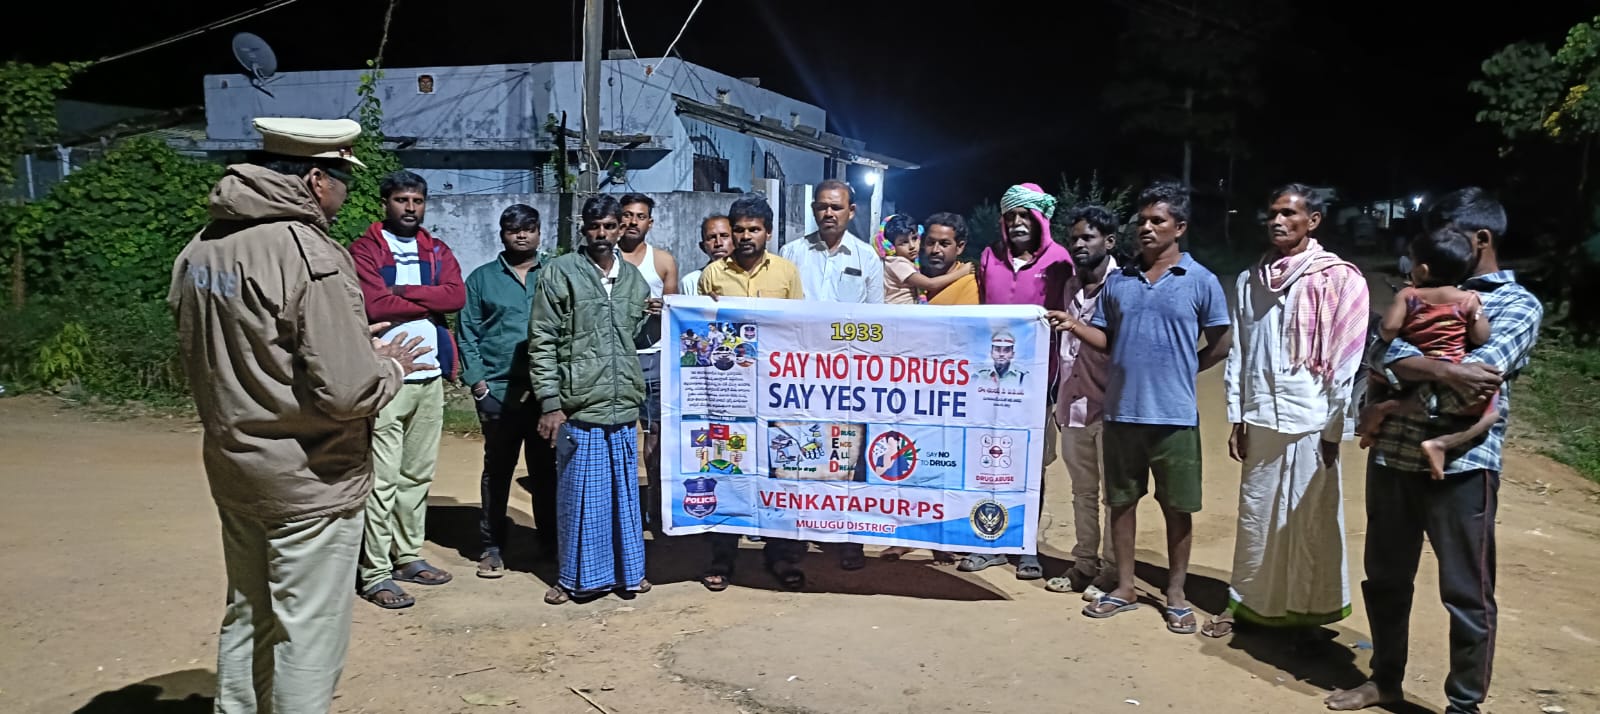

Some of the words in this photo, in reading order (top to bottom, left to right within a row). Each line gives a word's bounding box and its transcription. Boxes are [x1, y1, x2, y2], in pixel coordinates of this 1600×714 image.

[831, 323, 883, 342] 1933
[769, 351, 810, 378] SAY
[816, 353, 849, 380] NO
[853, 355, 884, 381] TO
[890, 356, 970, 386] DRUGS
[769, 382, 816, 410] SAY
[821, 385, 866, 412] YES
[872, 387, 907, 414] TO
[914, 389, 967, 417] LIFE
[685, 496, 716, 504] POLICE
[759, 490, 911, 517] VENKATAPUR
[917, 501, 945, 520] PS
[795, 519, 844, 530] MULUGU
[847, 521, 896, 534] DISTRICT
